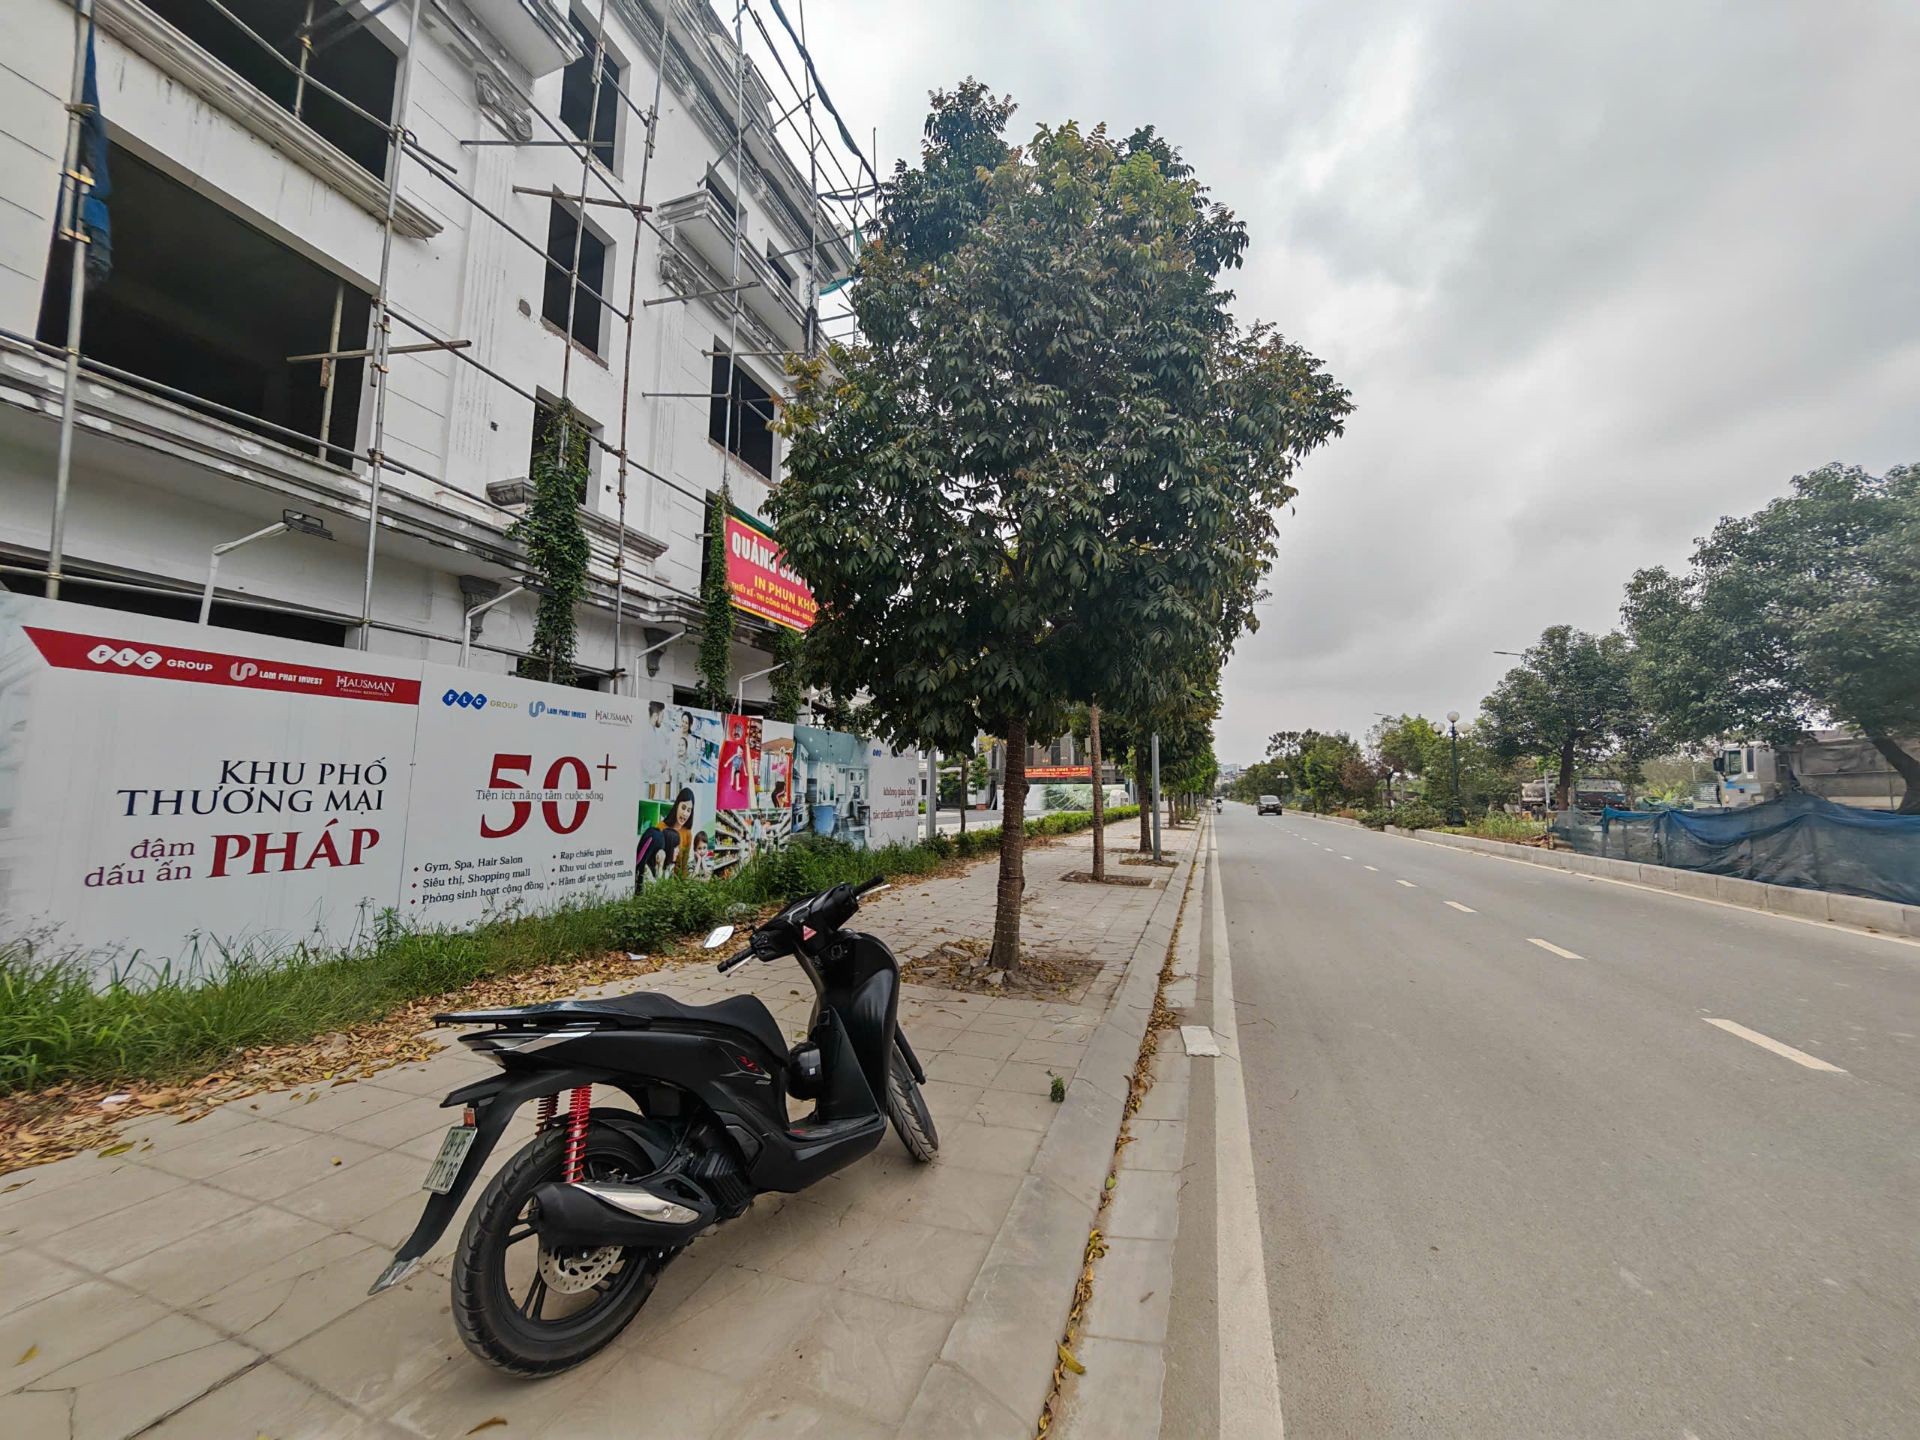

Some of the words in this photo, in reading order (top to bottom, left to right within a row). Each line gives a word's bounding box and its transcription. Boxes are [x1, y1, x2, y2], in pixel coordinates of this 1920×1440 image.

[731, 532, 777, 573] QUẢNG
[754, 575, 766, 591] IN
[768, 581, 796, 604] PHUN
[166, 659, 214, 671] GROUP
[259, 670, 277, 680] LAM
[278, 673, 297, 683] PHAT
[298, 676, 324, 686] INVEST
[336, 675, 396, 694] HAUSMAN
[489, 699, 519, 710] GROUP
[219, 760, 307, 785] KHU
[318, 757, 388, 785] PHỐ
[117, 786, 314, 817] THƯƠNG
[323, 790, 384, 815] MẠI
[475, 789, 498, 800] Tiện
[501, 790, 516, 800] ích
[518, 790, 543, 803] nâng
[564, 791, 583, 801] cuộc
[585, 789, 604, 801] sống
[130, 838, 195, 861] đậm
[205, 818, 380, 878] PHÁP
[595, 848, 613, 857] phim
[84, 862, 145, 888] dấu
[156, 860, 192, 882] ấn
[424, 862, 452, 873] Gym,
[454, 860, 475, 870] Spa,
[478, 858, 497, 867] Hair
[499, 856, 523, 865] Salon
[559, 864, 574, 873] Khu
[588, 862, 603, 870] chơi
[616, 869, 633, 877] minh
[422, 878, 445, 889] Siêu
[448, 875, 465, 885] thị,
[467, 871, 510, 884] Shopping
[512, 868, 531, 878] mall
[421, 893, 455, 905] Phòng
[456, 889, 477, 900] sinh
[502, 883, 523, 895] cộng
[524, 881, 544, 892] đồng
